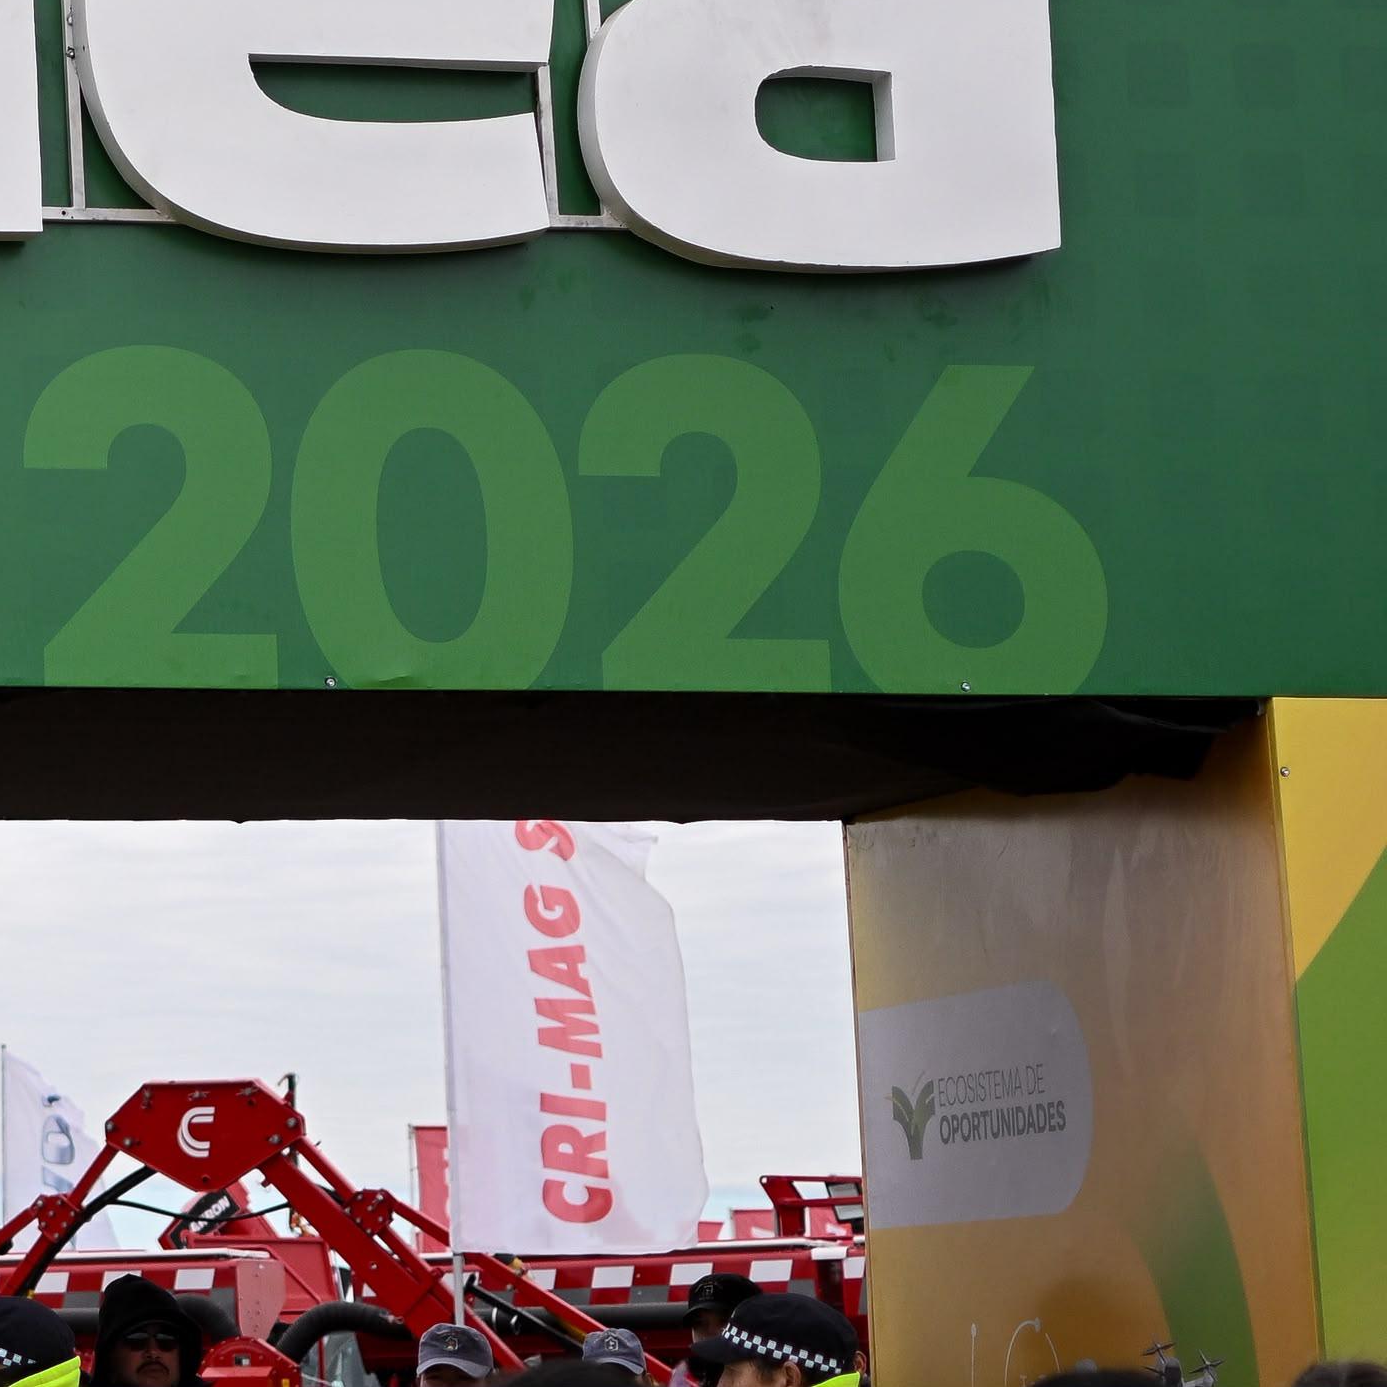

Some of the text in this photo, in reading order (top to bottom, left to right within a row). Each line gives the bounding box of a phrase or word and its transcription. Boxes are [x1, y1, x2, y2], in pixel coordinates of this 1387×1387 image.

[23, 345, 1108, 695] 2026
[523, 883, 614, 1223] CRI-MAG
[937, 1063, 1046, 1107] ECOSISTEMA DE
[939, 1100, 1067, 1145] OPORTUNIDADES
